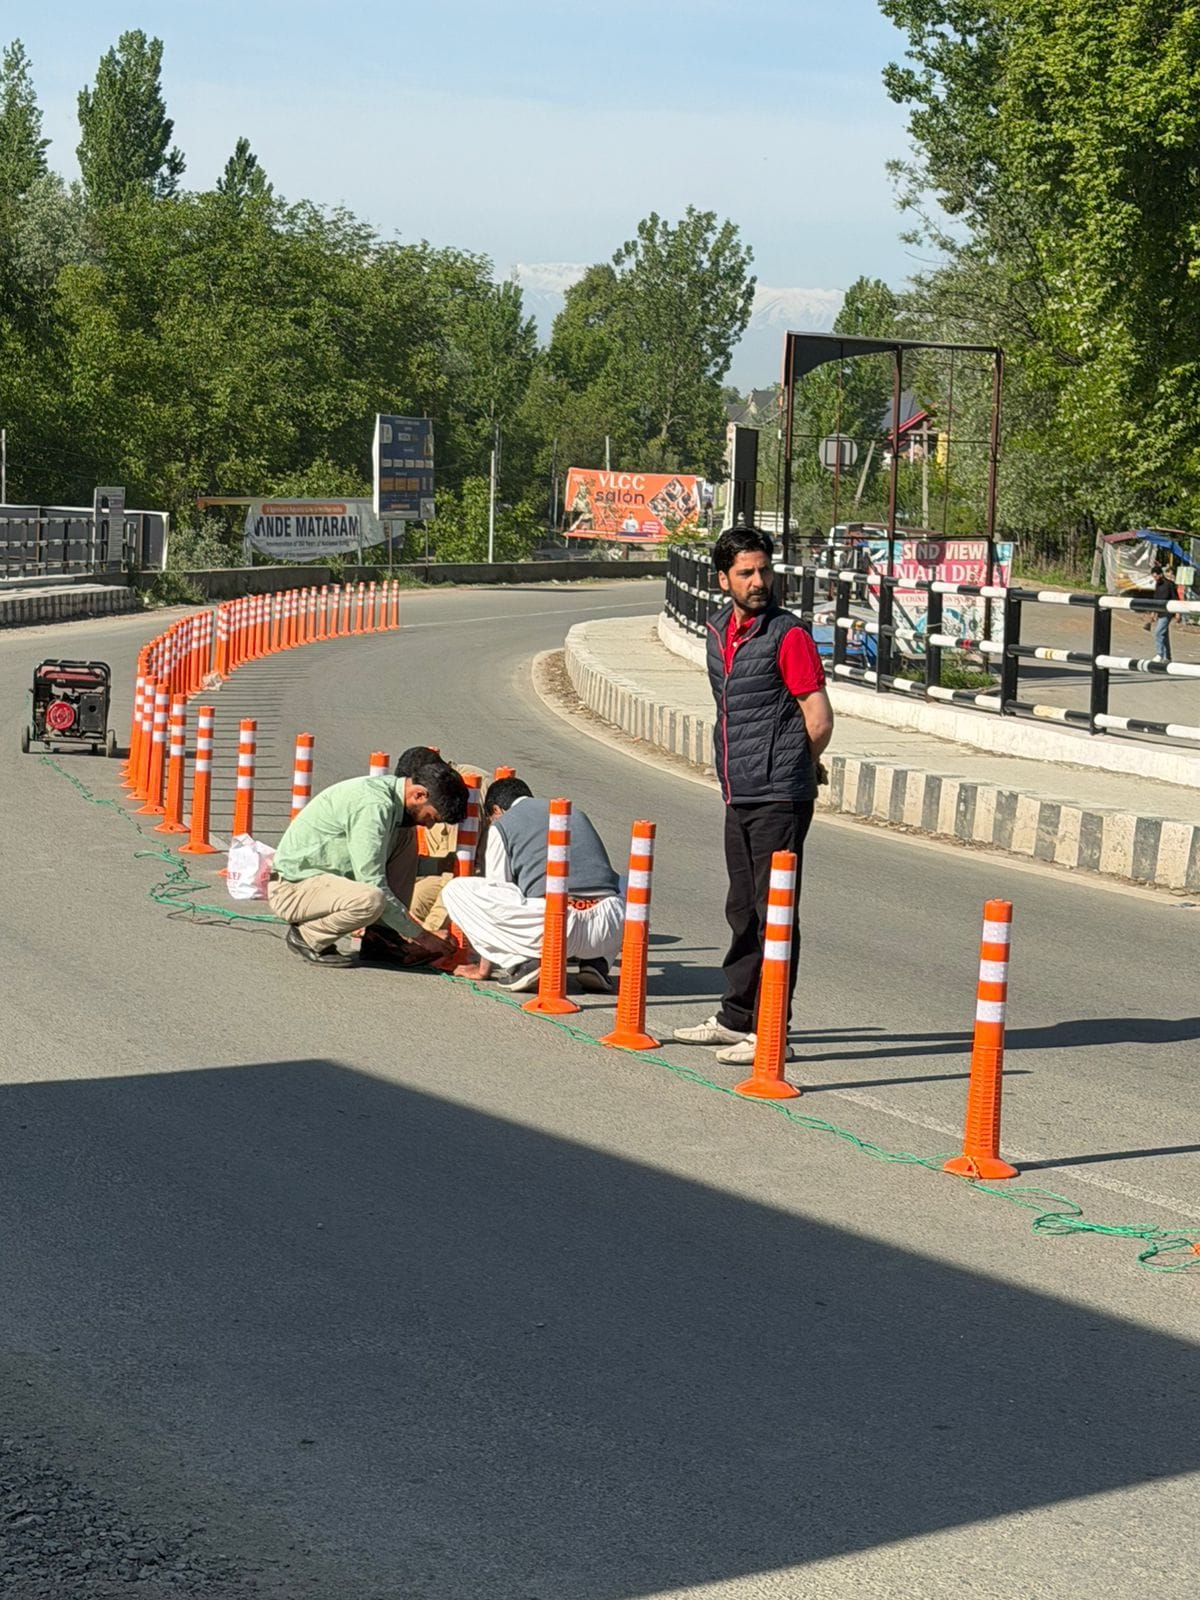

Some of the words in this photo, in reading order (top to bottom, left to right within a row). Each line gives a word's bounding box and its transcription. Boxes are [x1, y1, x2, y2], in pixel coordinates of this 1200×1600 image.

[599, 473, 646, 490] VLCC
[296, 516, 359, 537] MATARAM
[904, 543, 940, 560] SIND
[945, 543, 984, 560] VIEW
